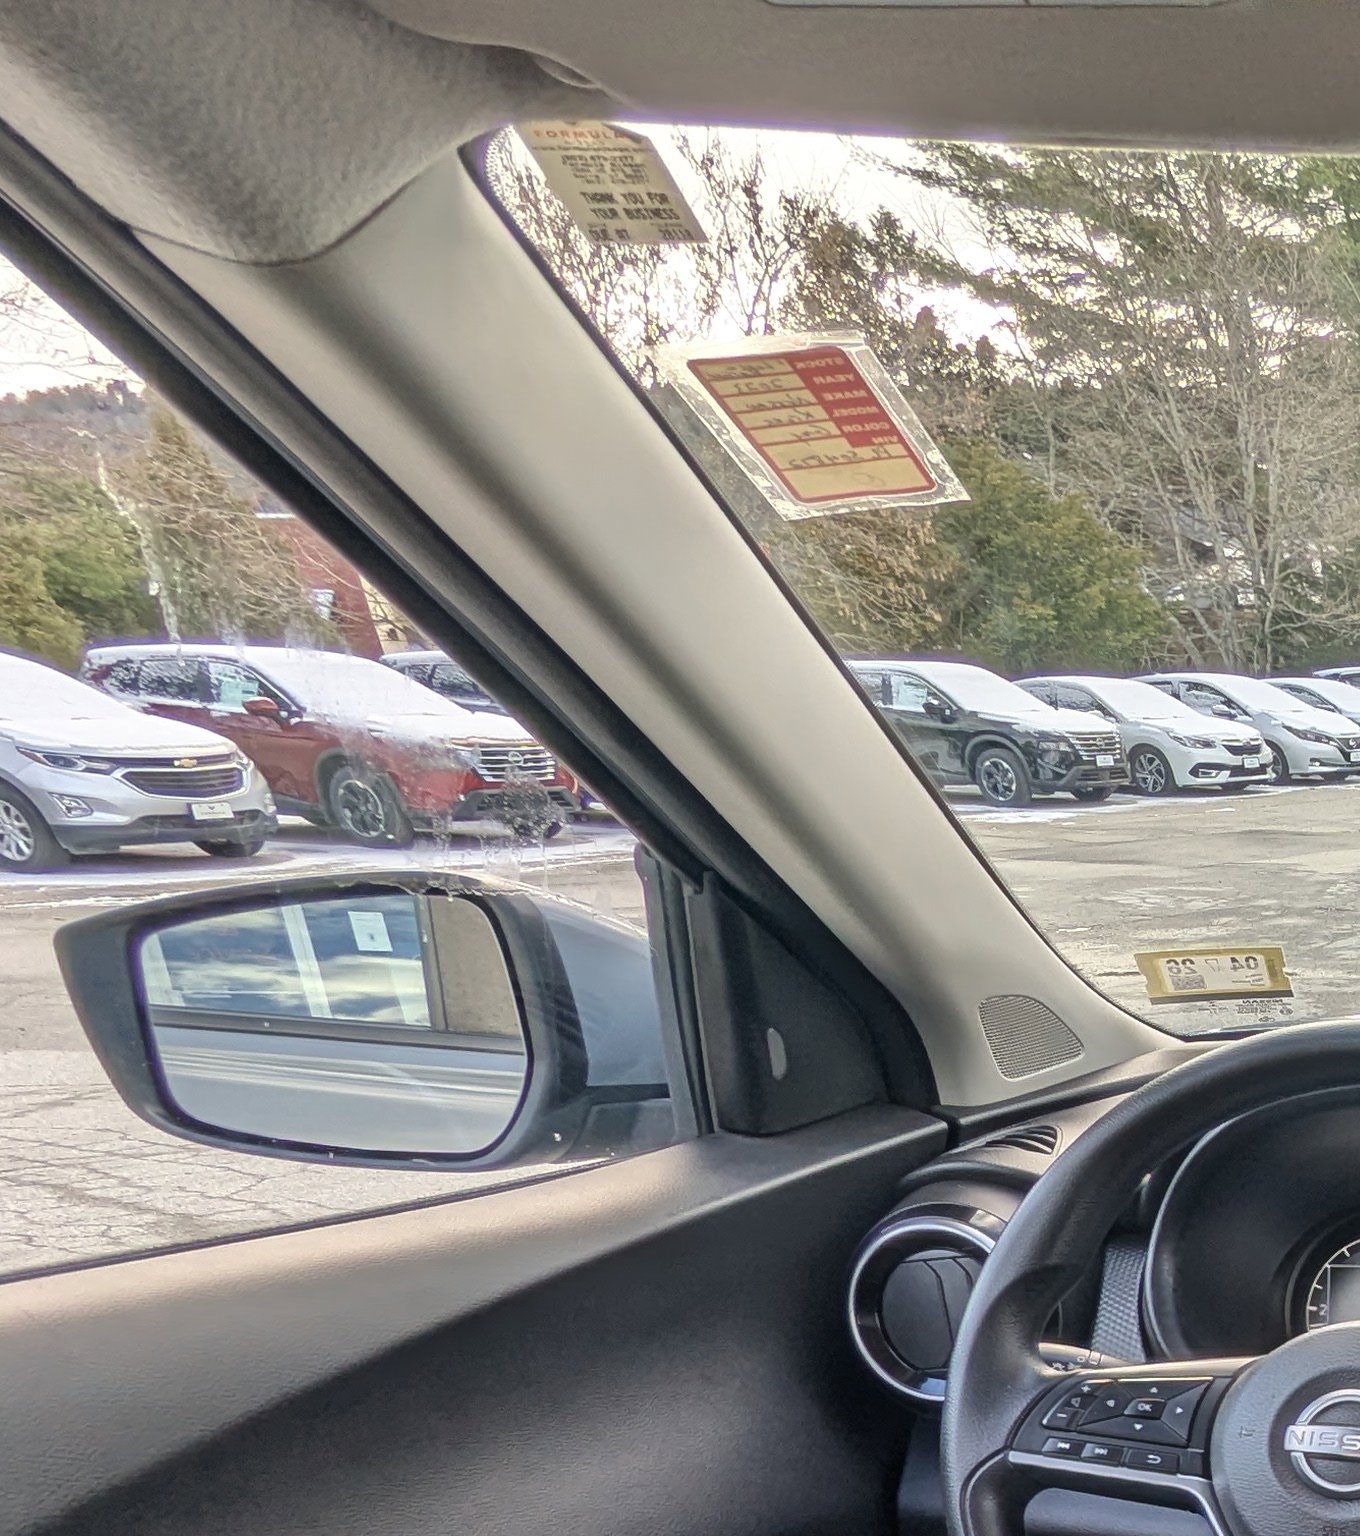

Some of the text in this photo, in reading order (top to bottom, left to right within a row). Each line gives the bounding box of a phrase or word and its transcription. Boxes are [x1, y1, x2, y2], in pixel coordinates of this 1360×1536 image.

[581, 192, 671, 206] THANK YOU FOR
[590, 208, 681, 221] YOUR BUSINESS
